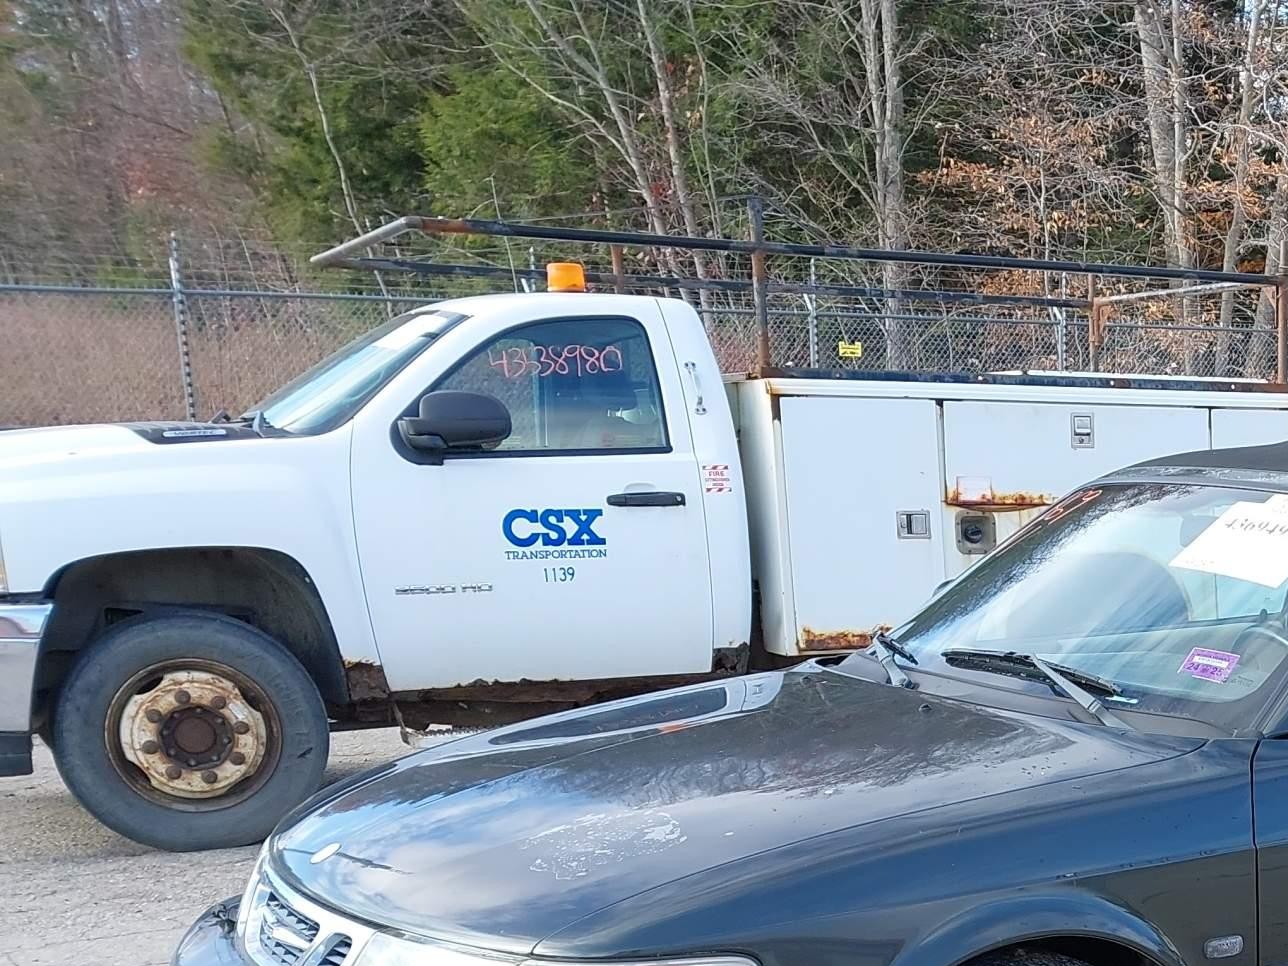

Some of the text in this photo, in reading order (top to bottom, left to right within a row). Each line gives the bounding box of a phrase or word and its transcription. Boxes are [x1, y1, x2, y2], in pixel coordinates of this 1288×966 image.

[502, 508, 607, 547] CSX
[505, 549, 607, 561] TRANSPORTATION
[543, 567, 575, 583] 1139
